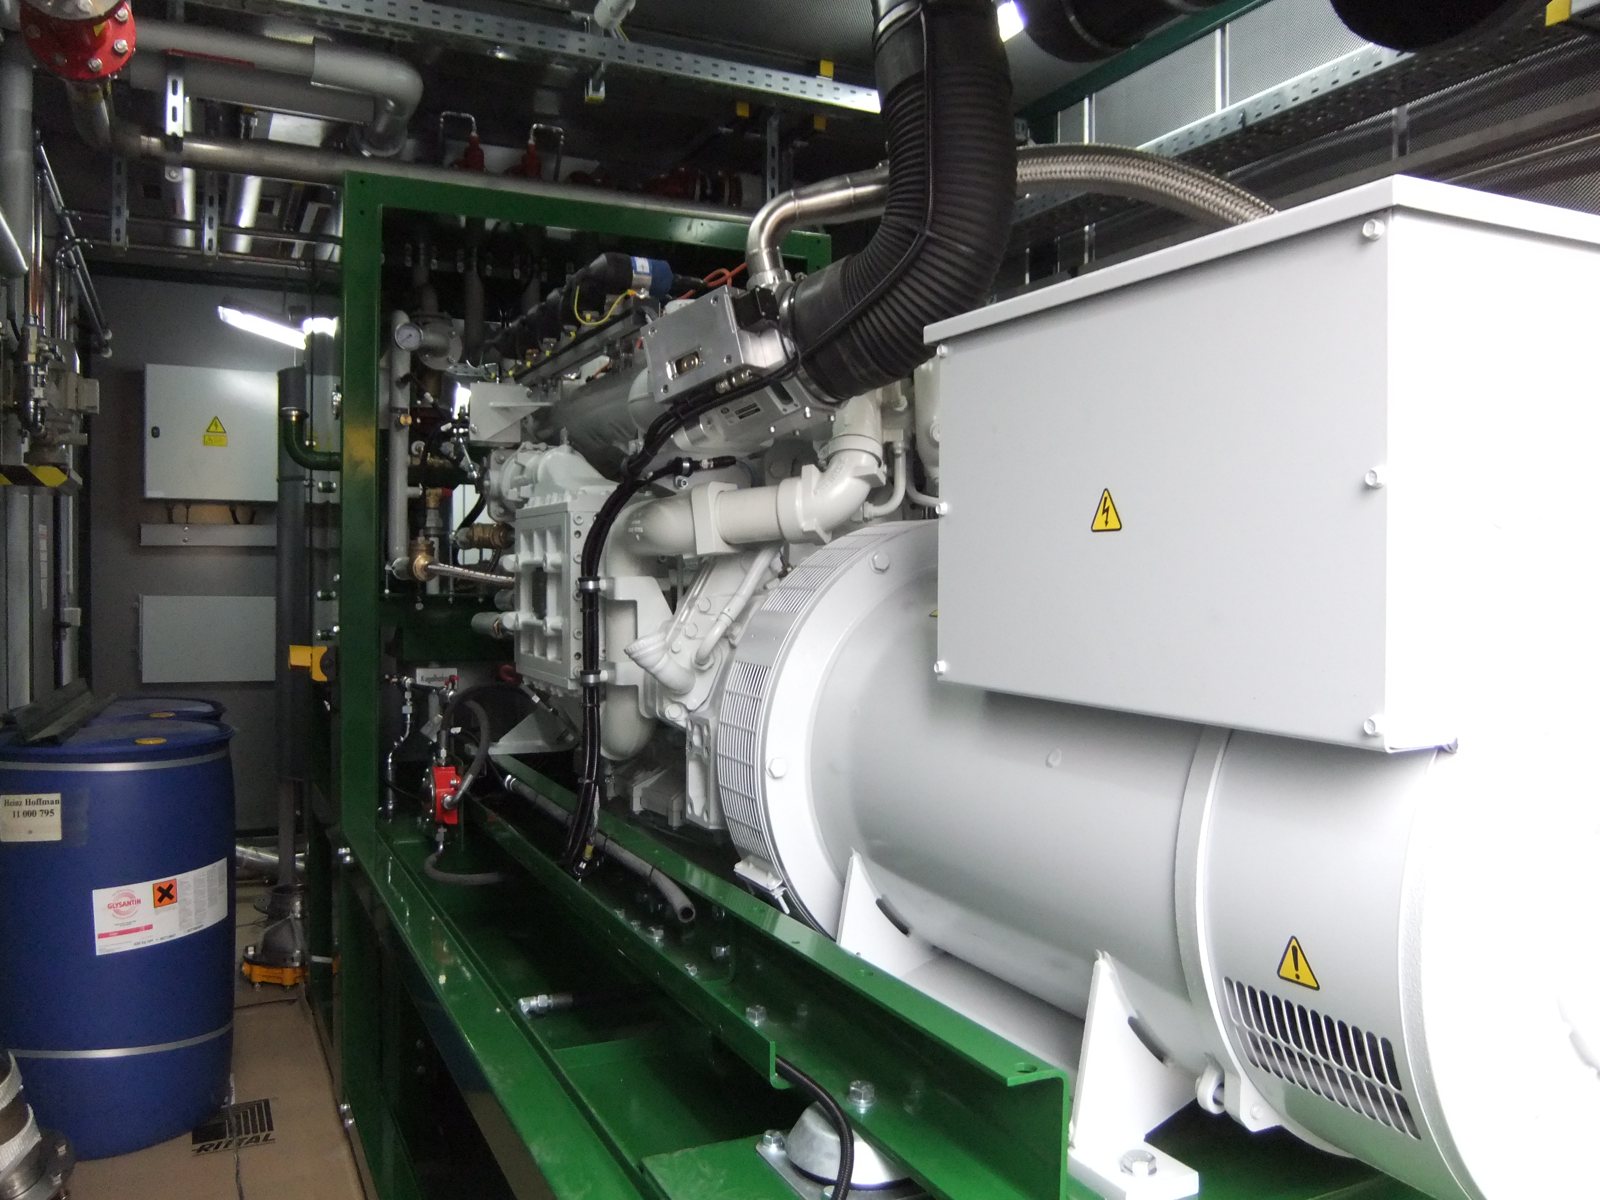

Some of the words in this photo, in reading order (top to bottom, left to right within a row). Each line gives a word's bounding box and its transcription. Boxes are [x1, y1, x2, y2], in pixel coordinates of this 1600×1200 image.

[25, 797, 60, 806] Hoffman
[12, 810, 20, 818] 11
[22, 809, 37, 818] 000
[39, 808, 55, 817] 795
[107, 898, 142, 909] GLYSANTIN
